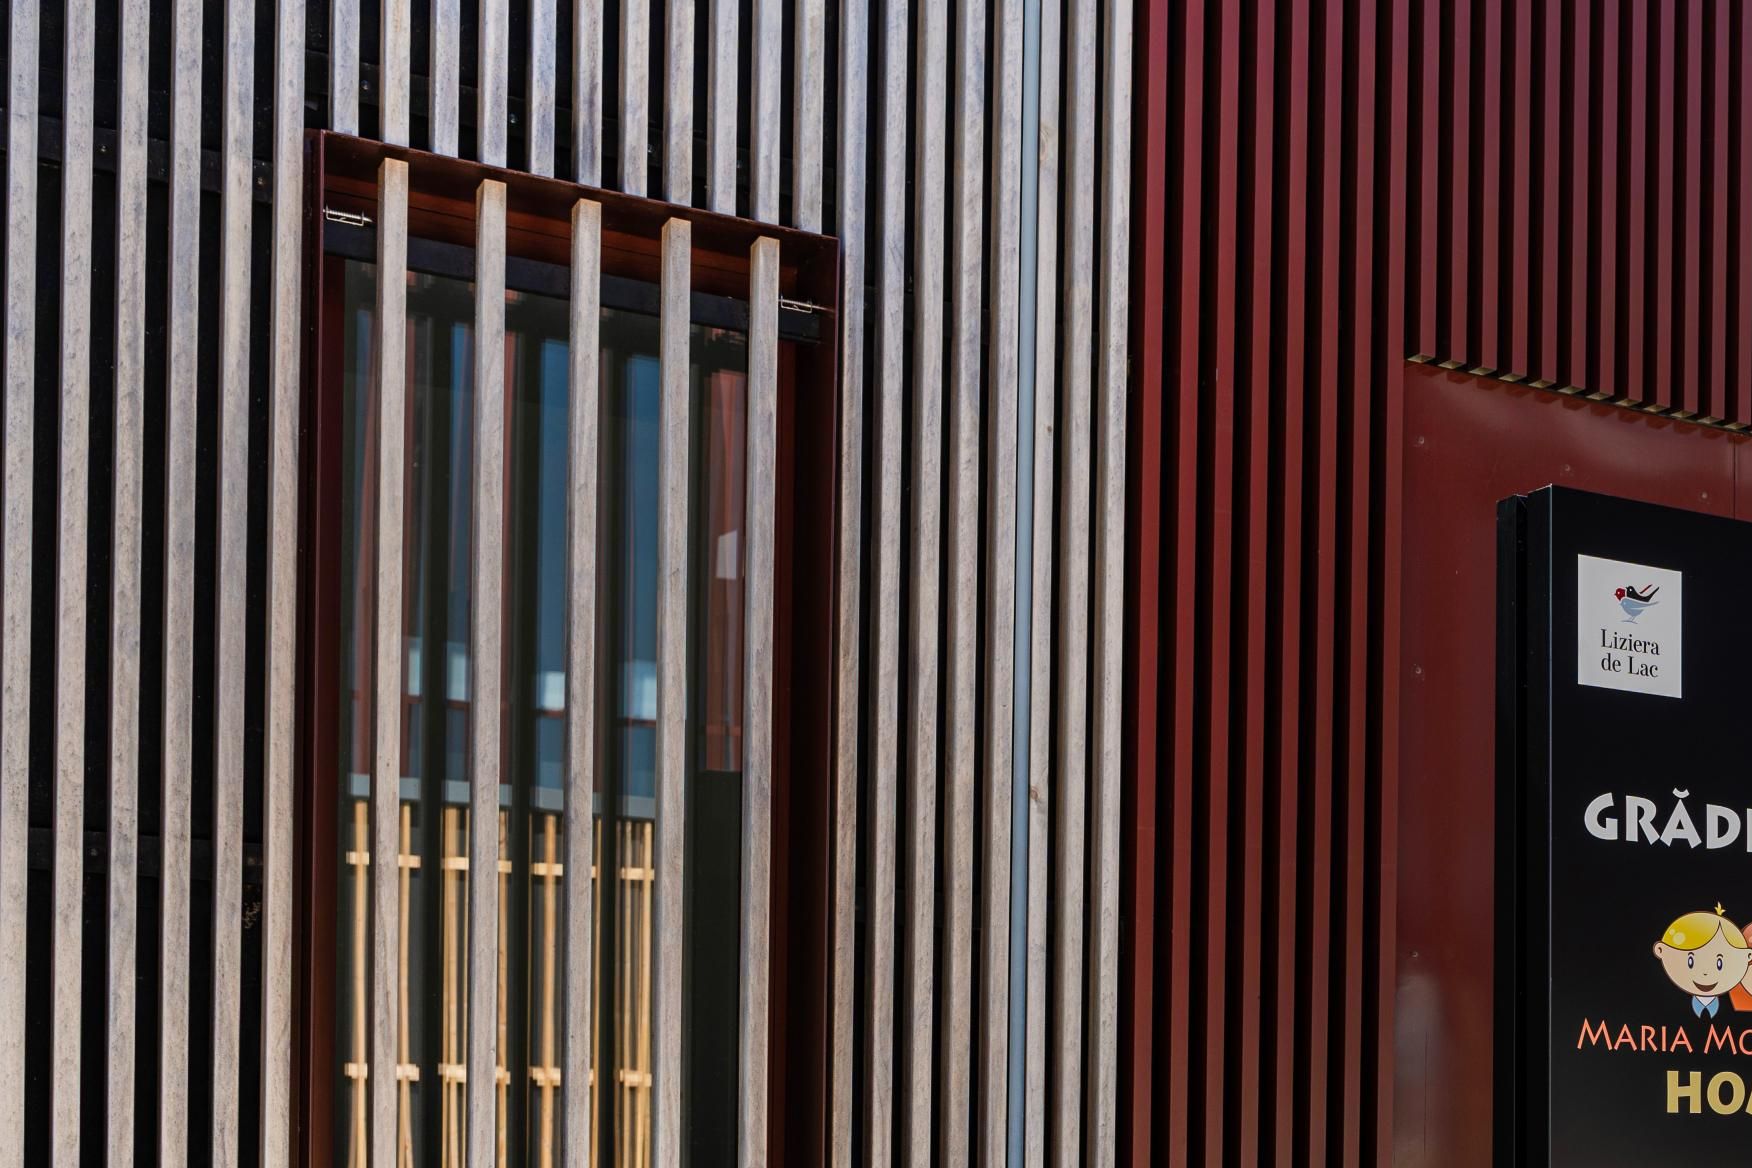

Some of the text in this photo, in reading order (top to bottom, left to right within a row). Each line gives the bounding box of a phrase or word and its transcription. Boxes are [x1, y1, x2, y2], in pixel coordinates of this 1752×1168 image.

[1600, 628, 1660, 656] Liziera
[1601, 652, 1659, 678] de Lac
[1577, 1017, 1694, 1054] MARIA
